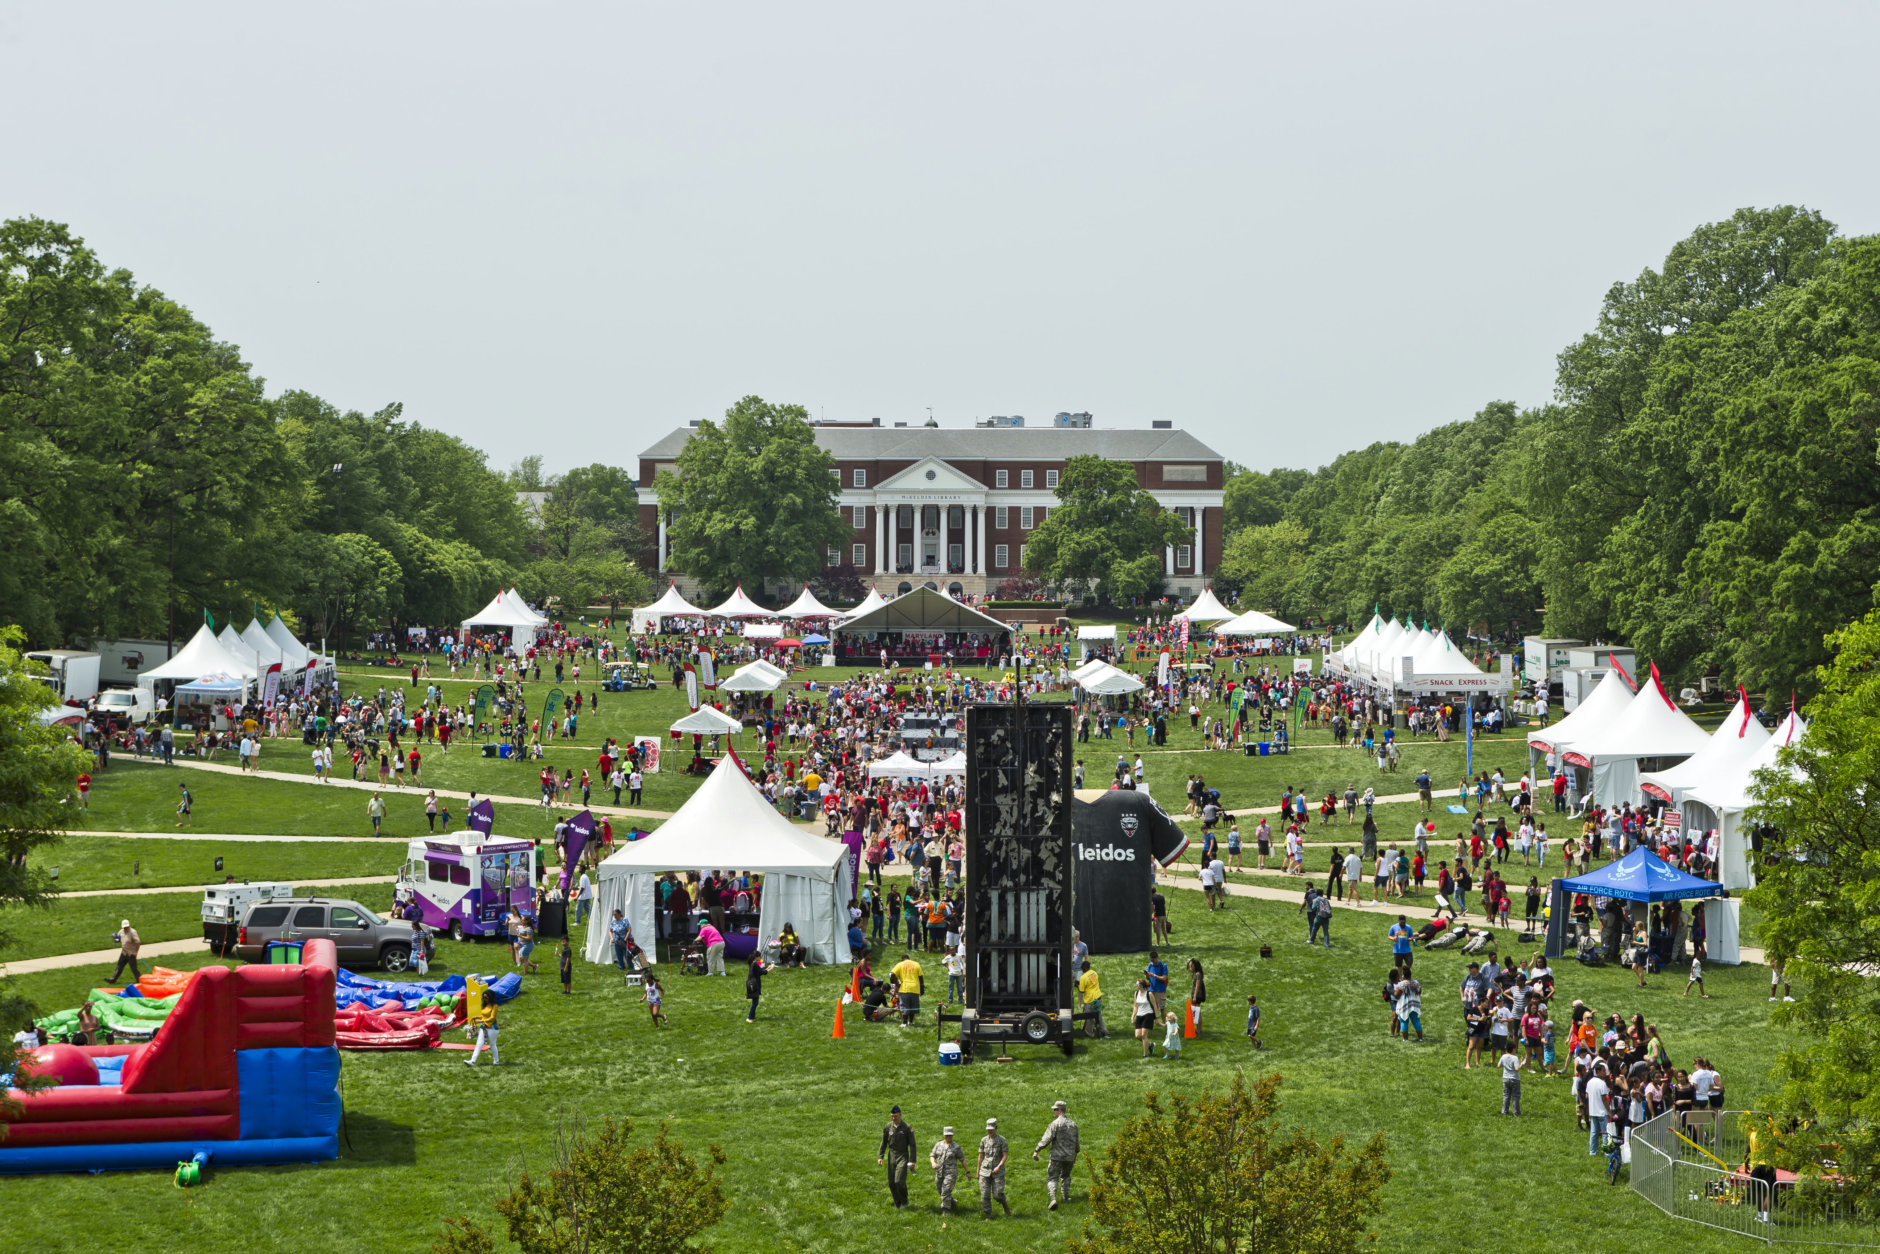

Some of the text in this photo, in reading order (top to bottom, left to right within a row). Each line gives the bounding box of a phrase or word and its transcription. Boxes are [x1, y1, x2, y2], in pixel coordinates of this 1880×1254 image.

[575, 825, 589, 835] leidos
[1078, 843, 1136, 861] leidos
[1589, 885, 1612, 896] FORCE
[1615, 889, 1634, 898] ROTC
[1663, 889, 1711, 900] AIR FORCE ROTC
[437, 896, 450, 905] leidos
